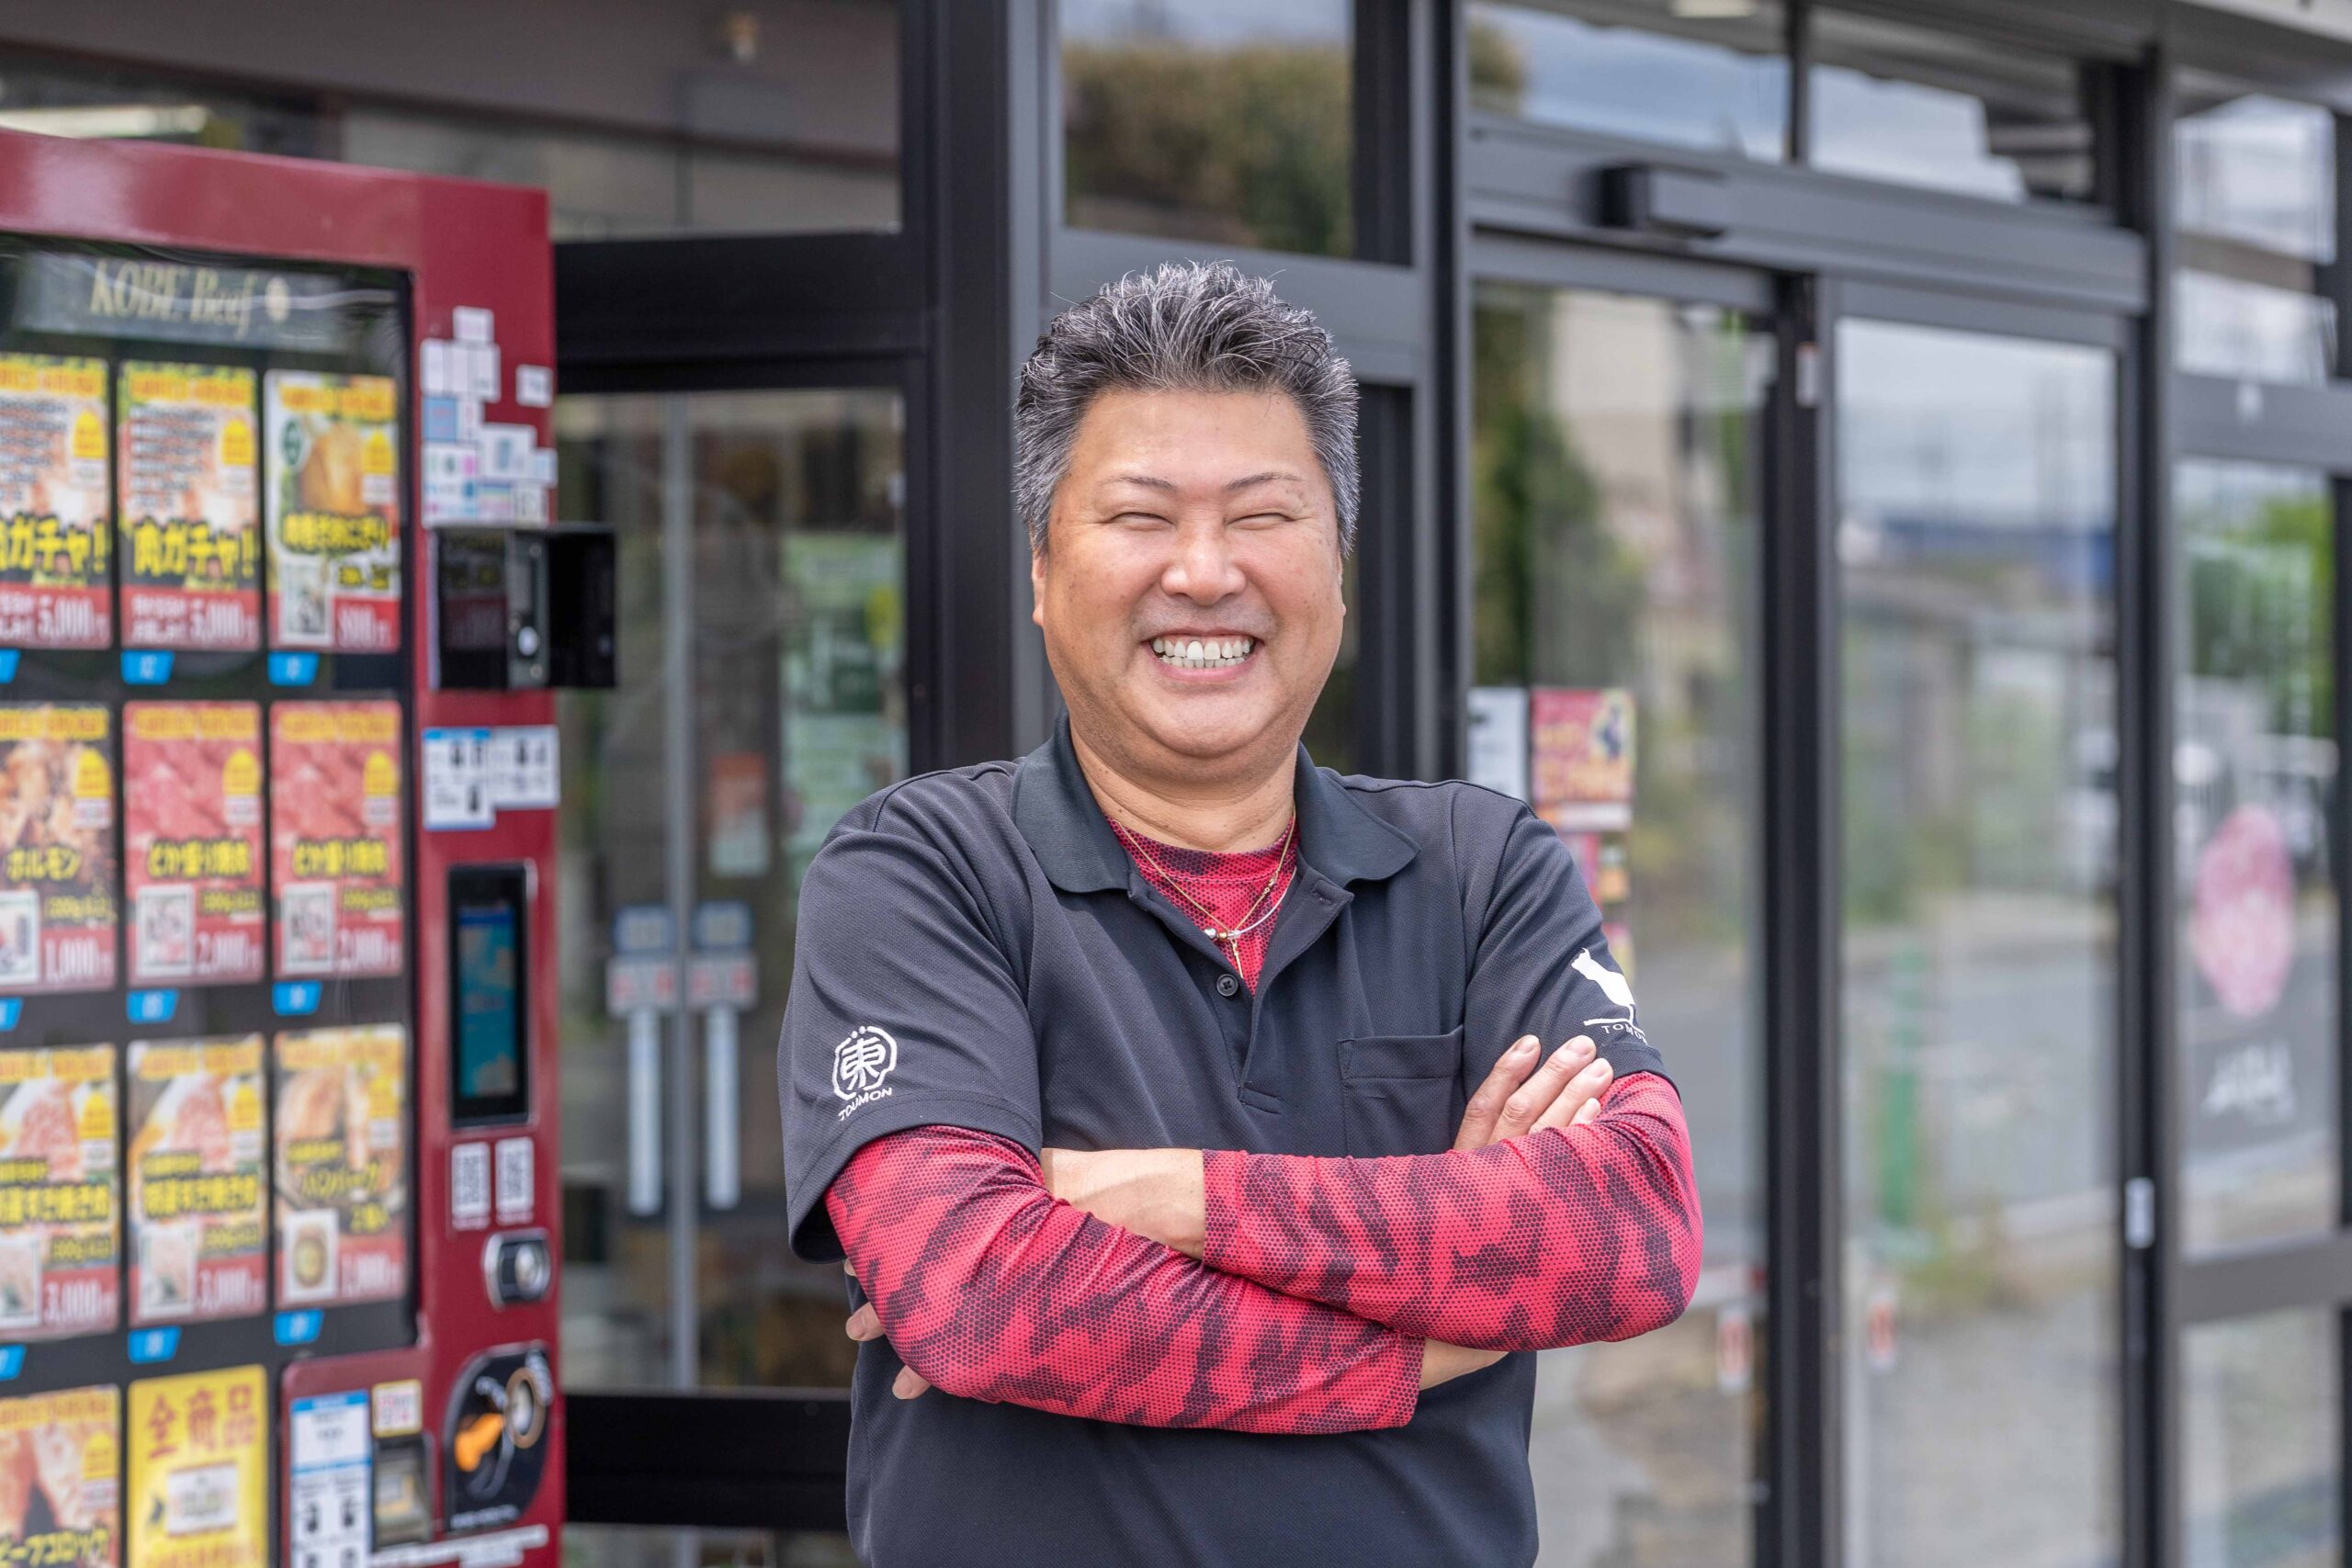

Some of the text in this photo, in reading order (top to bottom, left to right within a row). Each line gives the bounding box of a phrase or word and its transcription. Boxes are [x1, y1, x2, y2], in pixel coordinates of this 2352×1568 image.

[90, 260, 258, 341] KOBE Beef
[0, 516, 106, 573] ガチャ!
[8, 845, 80, 882] ホルモン
[840, 1036, 886, 1090] 東
[148, 1384, 258, 1459] 全商品
